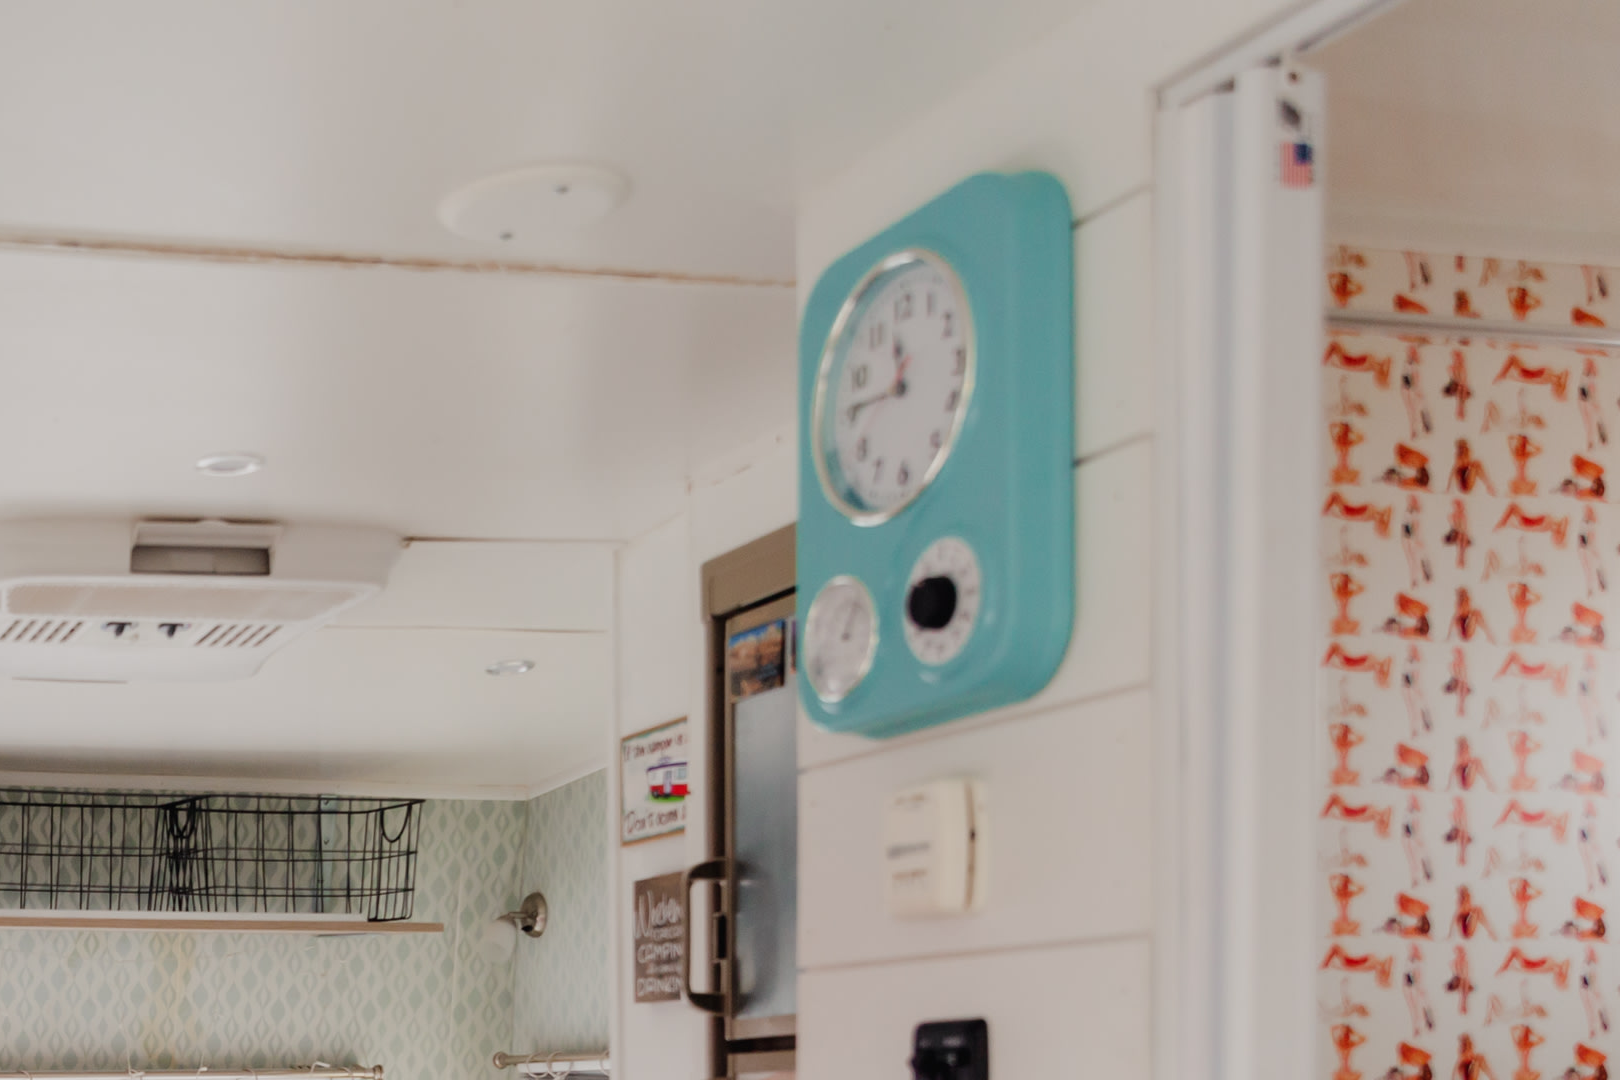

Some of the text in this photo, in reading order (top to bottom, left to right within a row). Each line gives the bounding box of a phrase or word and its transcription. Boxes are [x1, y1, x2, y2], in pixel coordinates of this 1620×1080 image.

[893, 293, 912, 323] 12
[926, 292, 935, 318] 1
[869, 322, 883, 350] 11
[941, 312, 953, 339] 2
[850, 364, 869, 389] 10
[897, 461, 909, 486] 6
